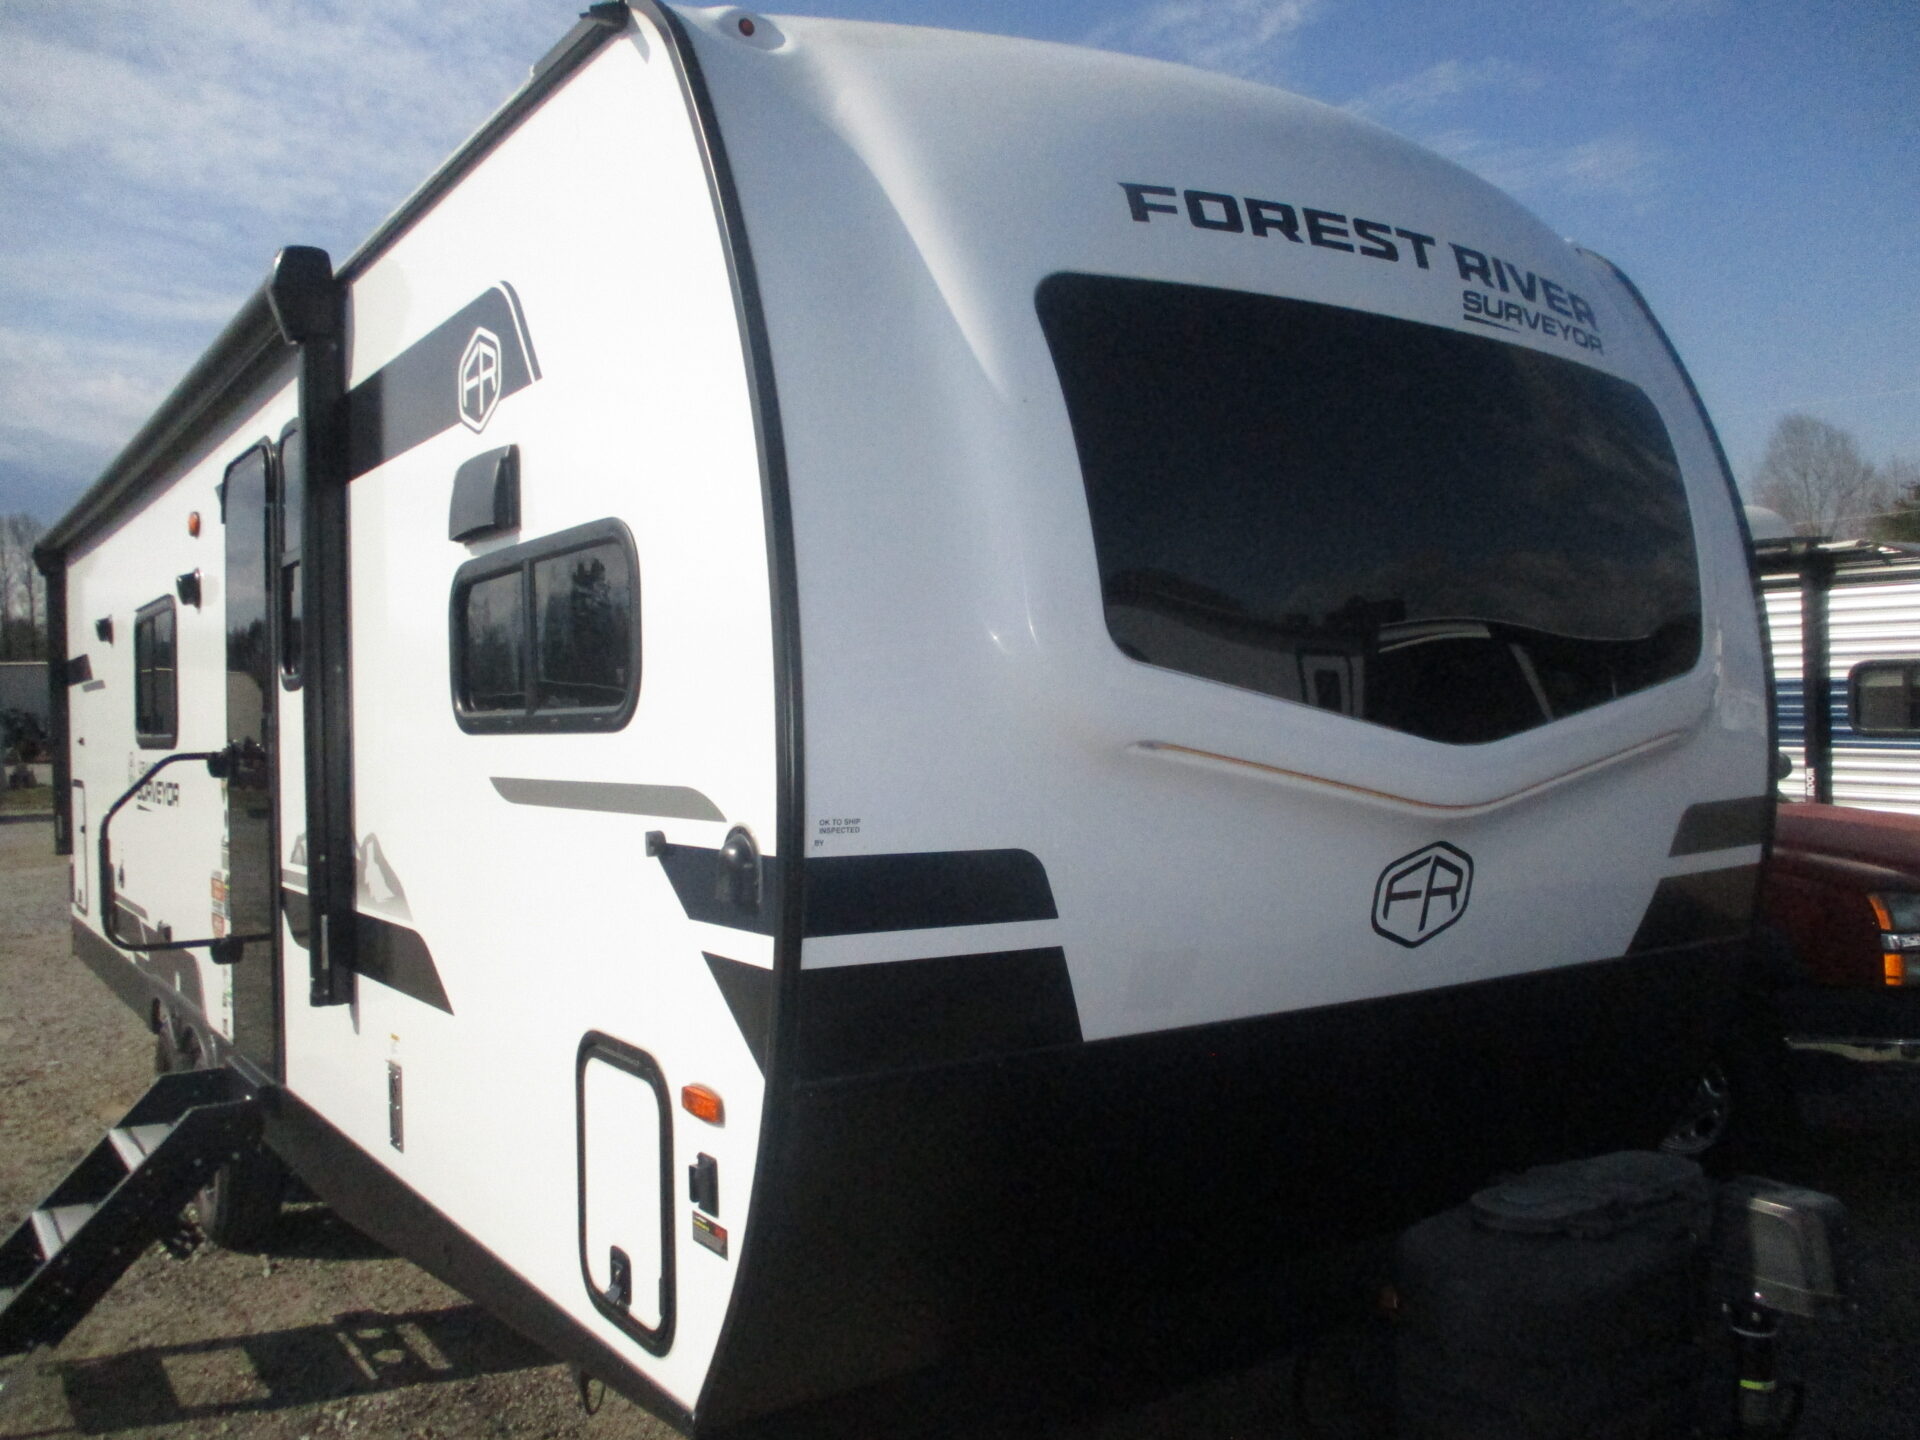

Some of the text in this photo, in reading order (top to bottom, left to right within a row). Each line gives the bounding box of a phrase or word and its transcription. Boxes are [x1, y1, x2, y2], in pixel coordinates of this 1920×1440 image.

[1118, 182, 1597, 329] FOREST RIVER
[1463, 290, 1605, 356] SURVEYOR
[819, 826, 860, 834] INSPECTED
